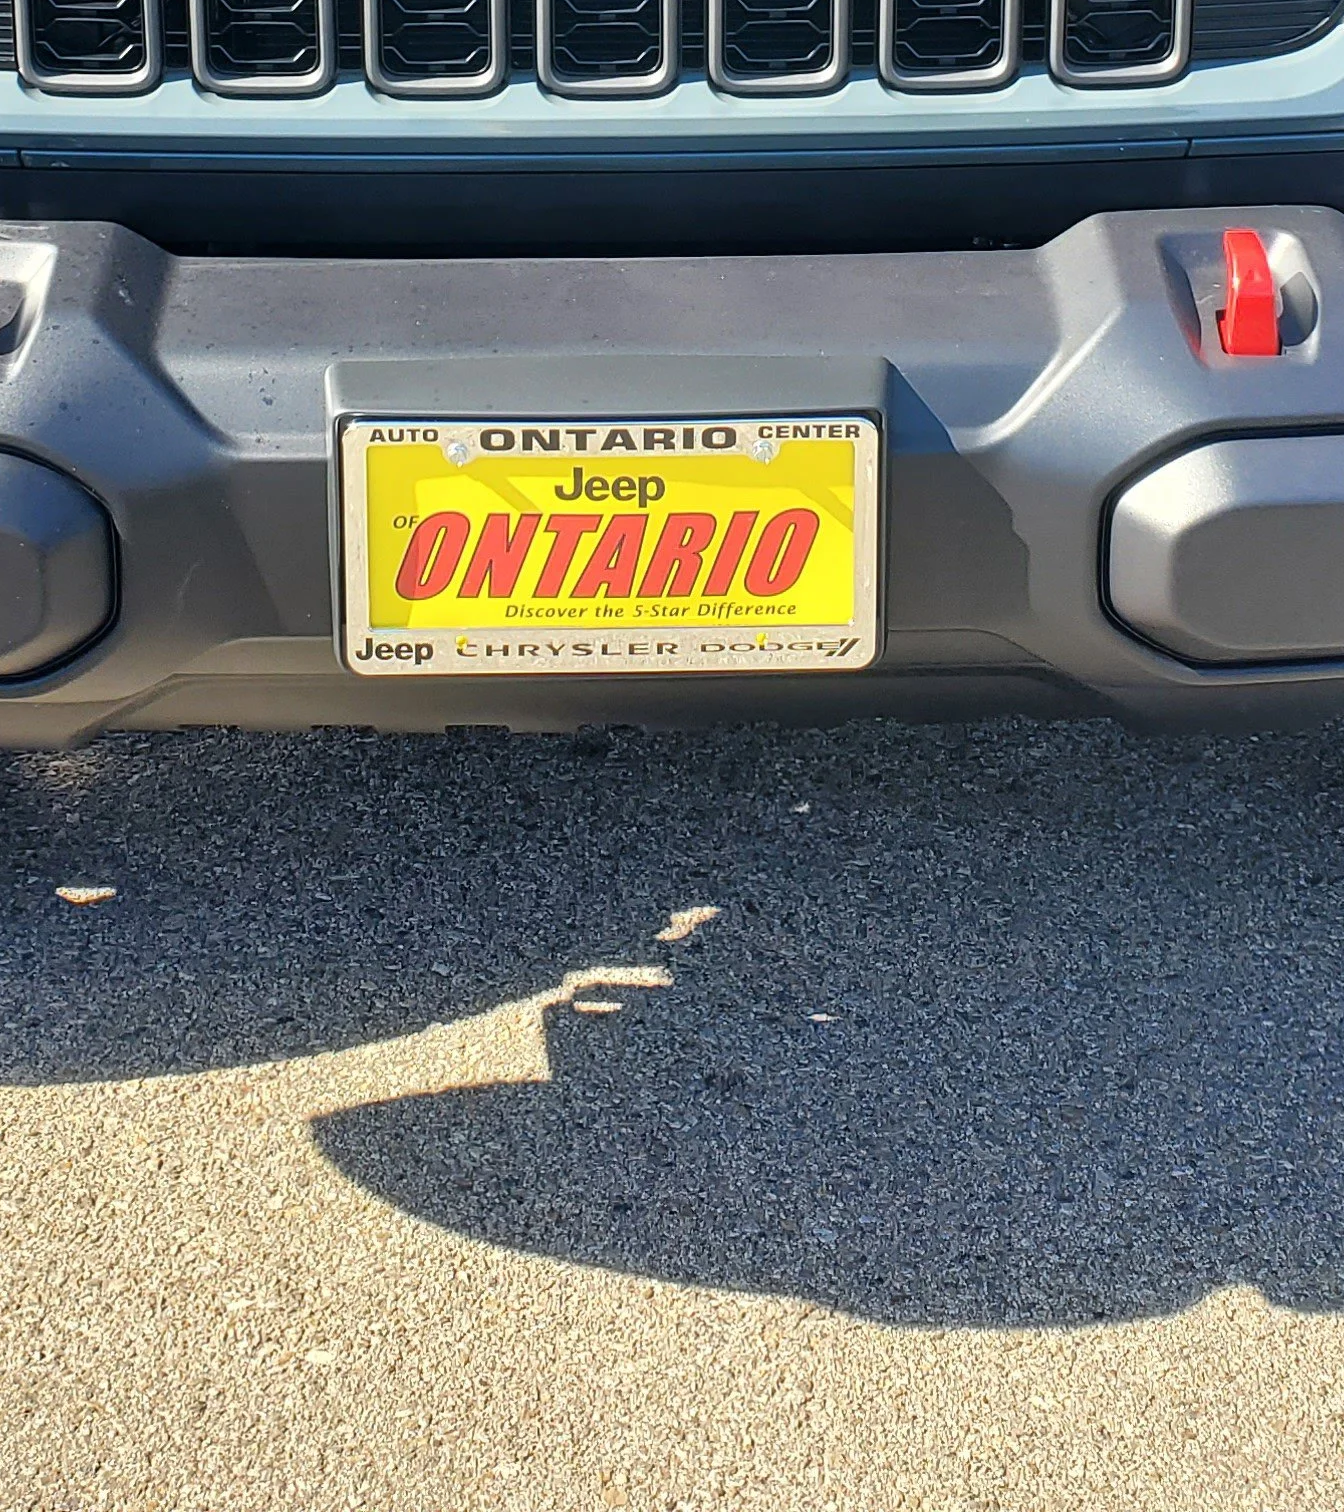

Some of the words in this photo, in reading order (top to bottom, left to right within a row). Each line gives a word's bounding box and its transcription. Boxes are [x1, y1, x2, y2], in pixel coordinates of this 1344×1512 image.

[369, 428, 439, 443] AUTO
[479, 426, 737, 452] ONTARIO
[758, 424, 860, 439] CENTER
[554, 466, 666, 508] Jeep
[393, 515, 419, 530] OF
[394, 508, 820, 601] ONTARIO
[505, 604, 588, 619] Discover
[595, 603, 624, 619] the
[632, 603, 690, 618] 5-Star
[697, 602, 797, 620] Difference
[355, 638, 434, 665] Jeep
[456, 642, 679, 657] CHRYSLER
[700, 640, 843, 654] DODGE
